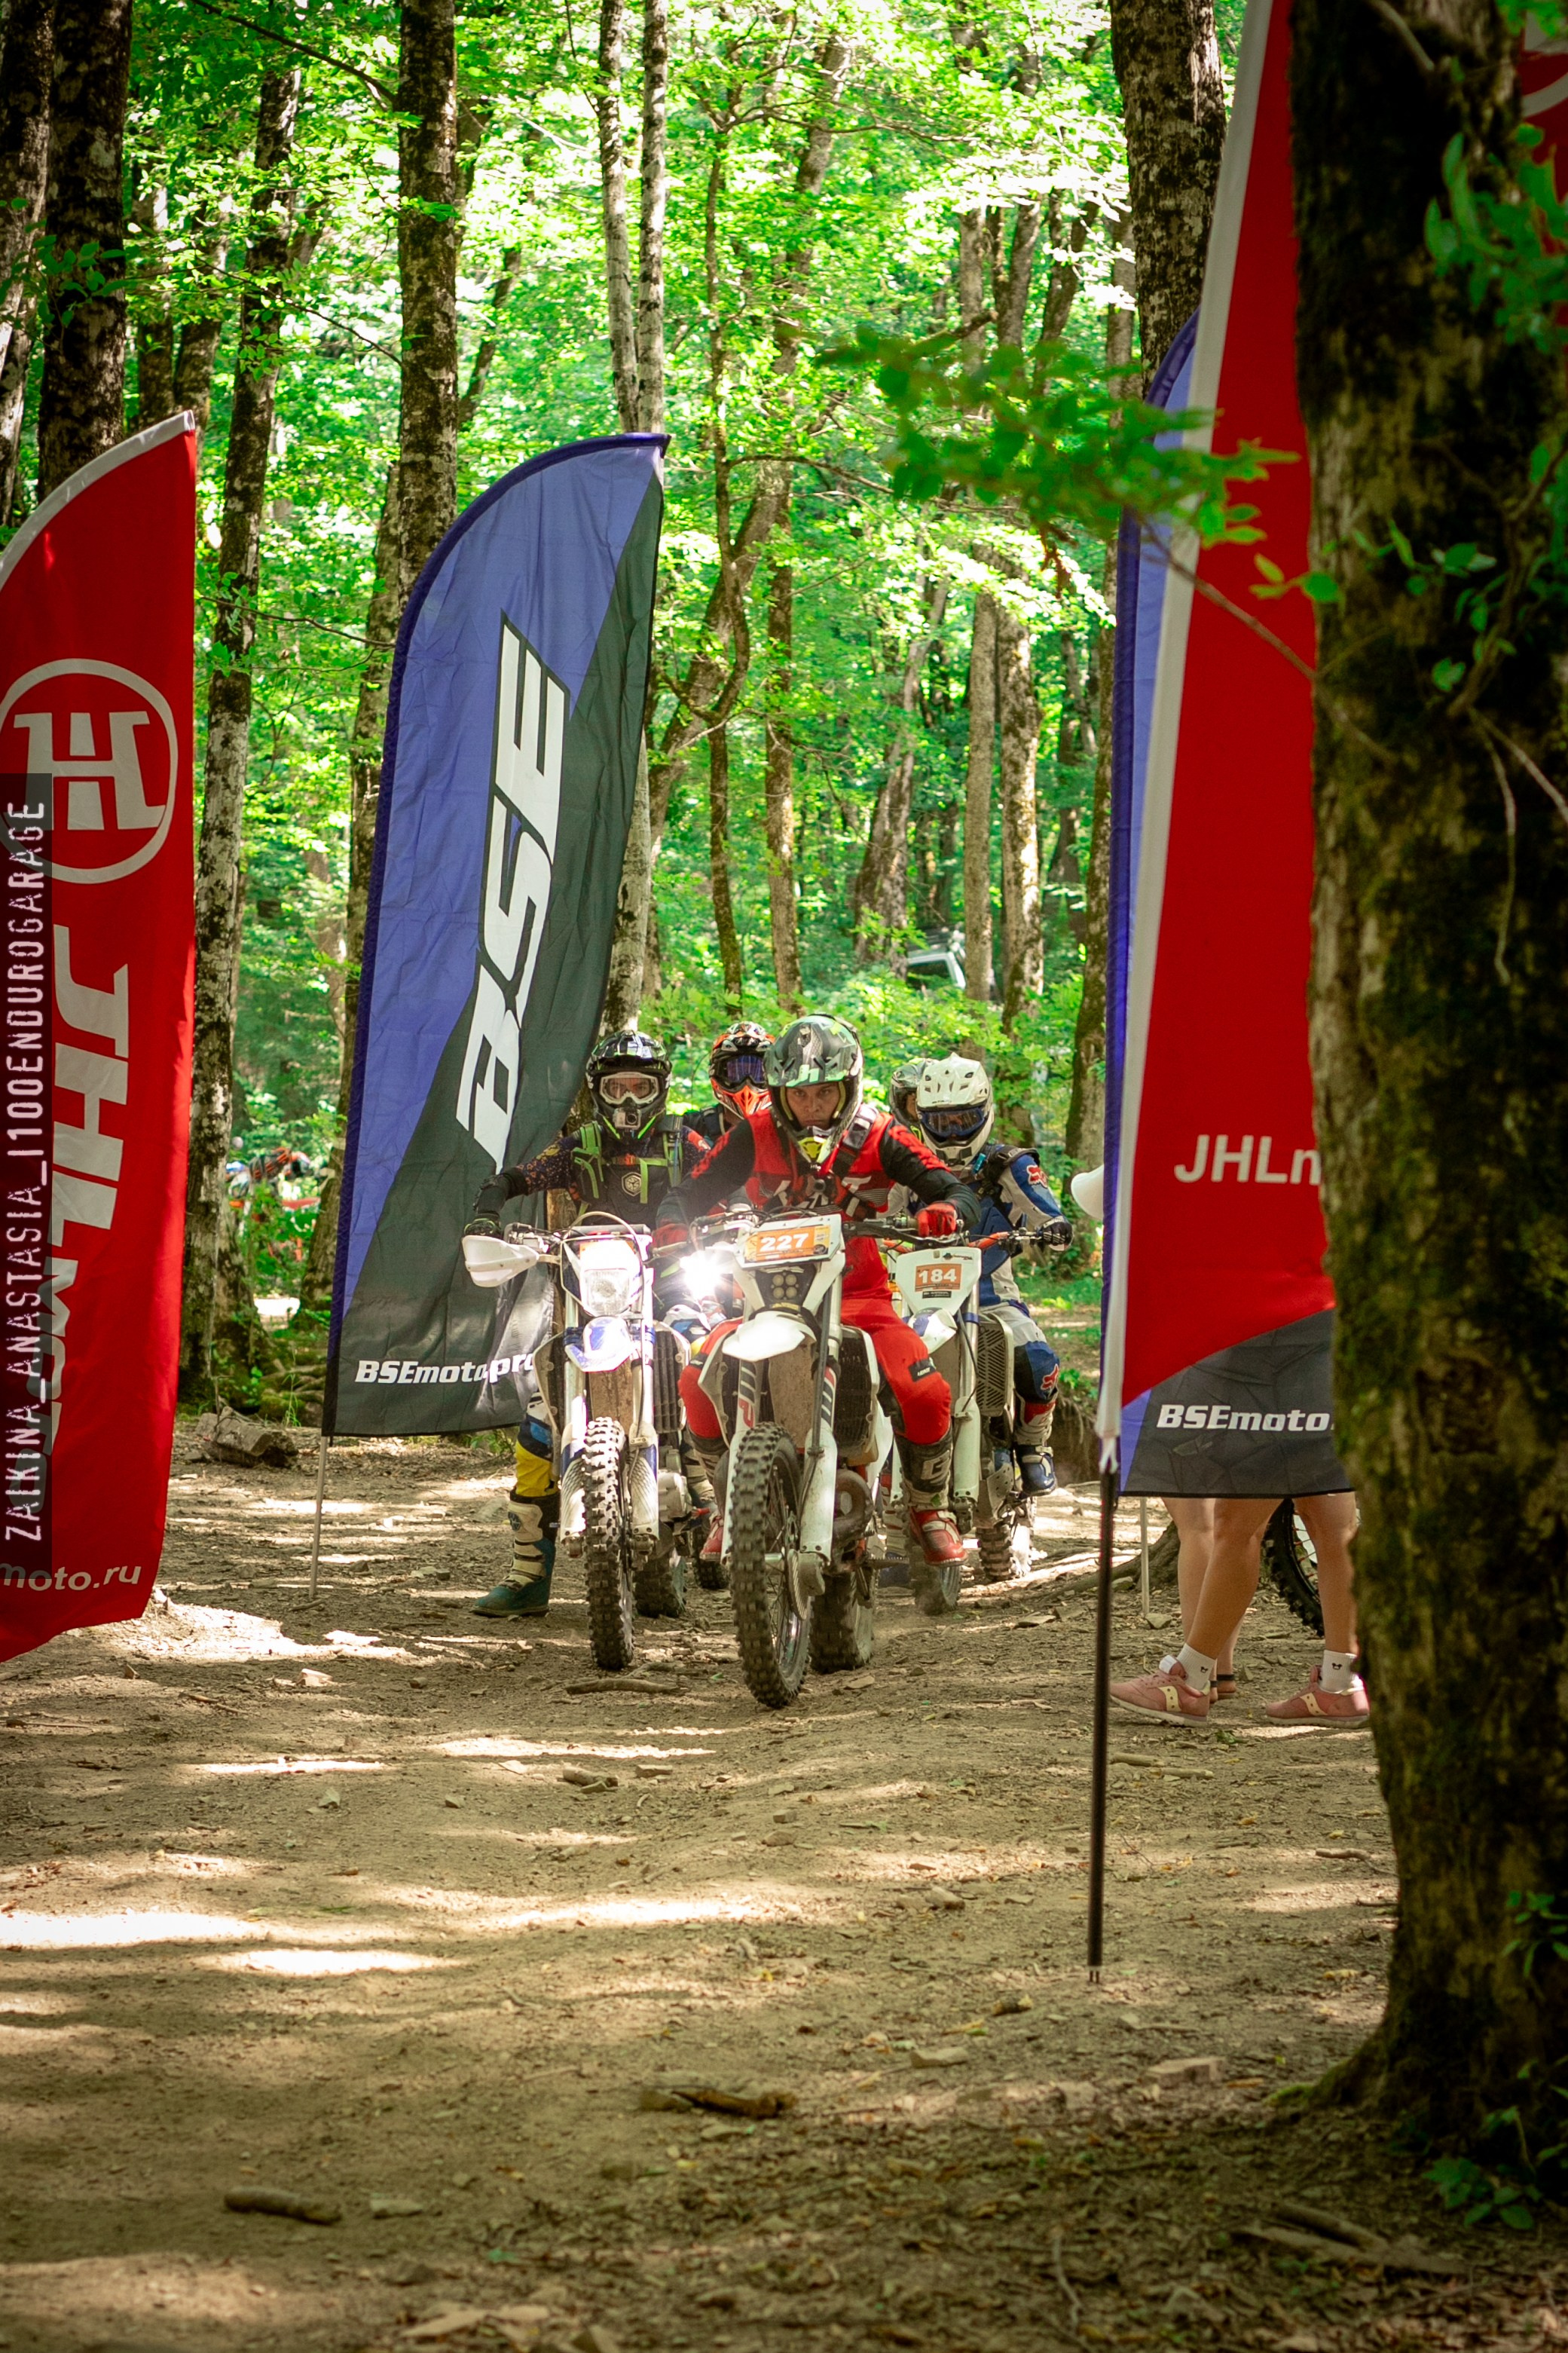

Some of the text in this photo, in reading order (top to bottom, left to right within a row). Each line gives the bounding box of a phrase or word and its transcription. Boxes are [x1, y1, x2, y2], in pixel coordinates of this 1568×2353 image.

[455, 624, 564, 1174] BSE
[760, 1232, 809, 1252] 227
[918, 1268, 957, 1284] 184
